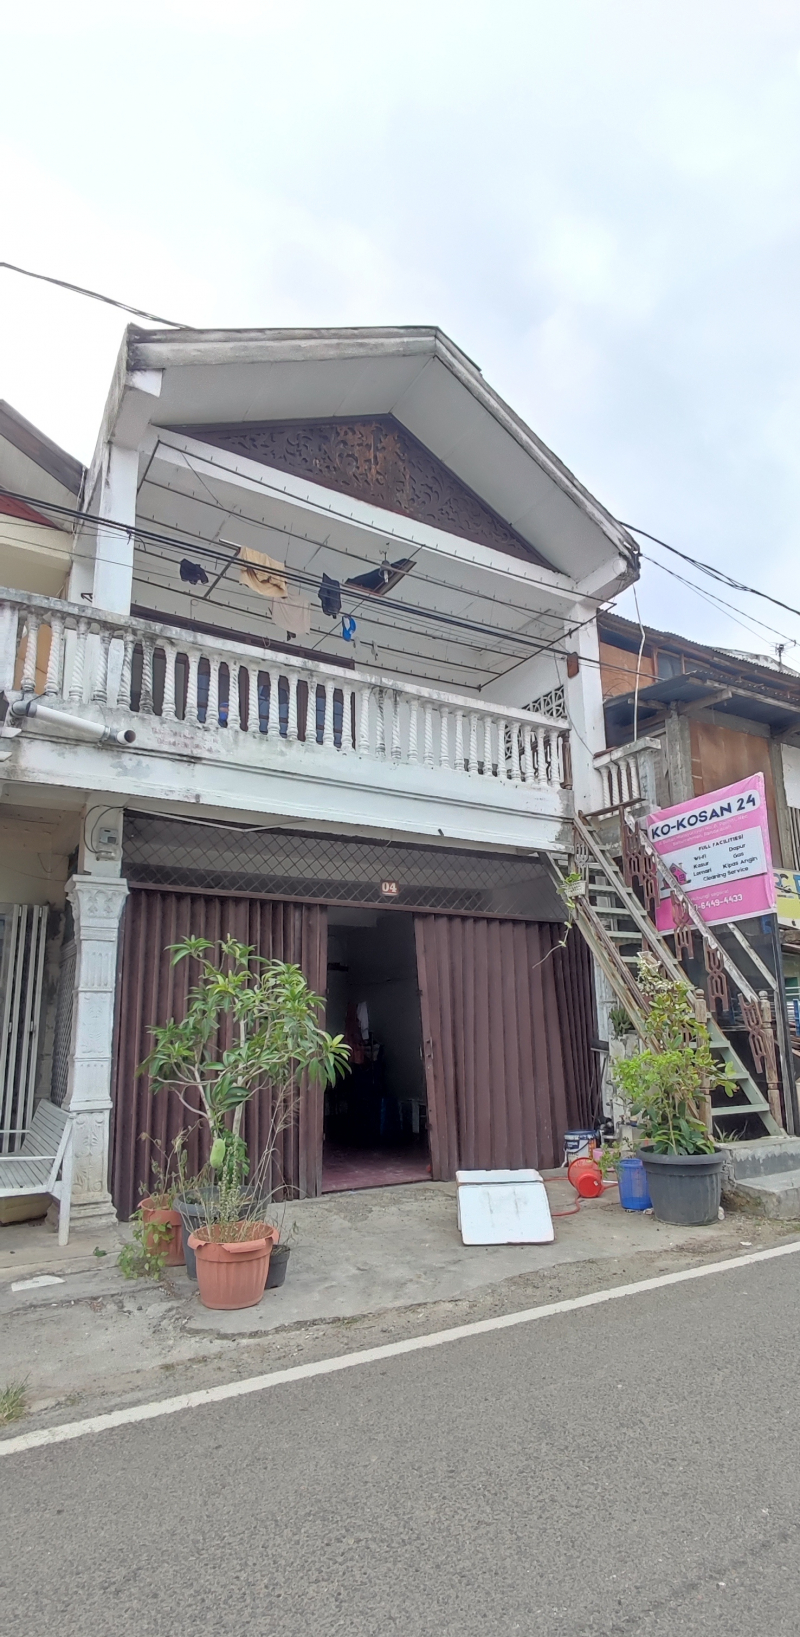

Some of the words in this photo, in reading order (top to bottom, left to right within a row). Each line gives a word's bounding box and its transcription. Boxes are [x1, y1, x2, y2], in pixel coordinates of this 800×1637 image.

[651, 803, 732, 840] KO-KOSAN
[737, 794, 756, 812] 24
[728, 843, 746, 852] Dapur
[740, 856, 758, 864] Angin
[703, 872, 727, 881] Cleaning
[727, 866, 749, 876] Service
[381, 881, 397, 893] 04
